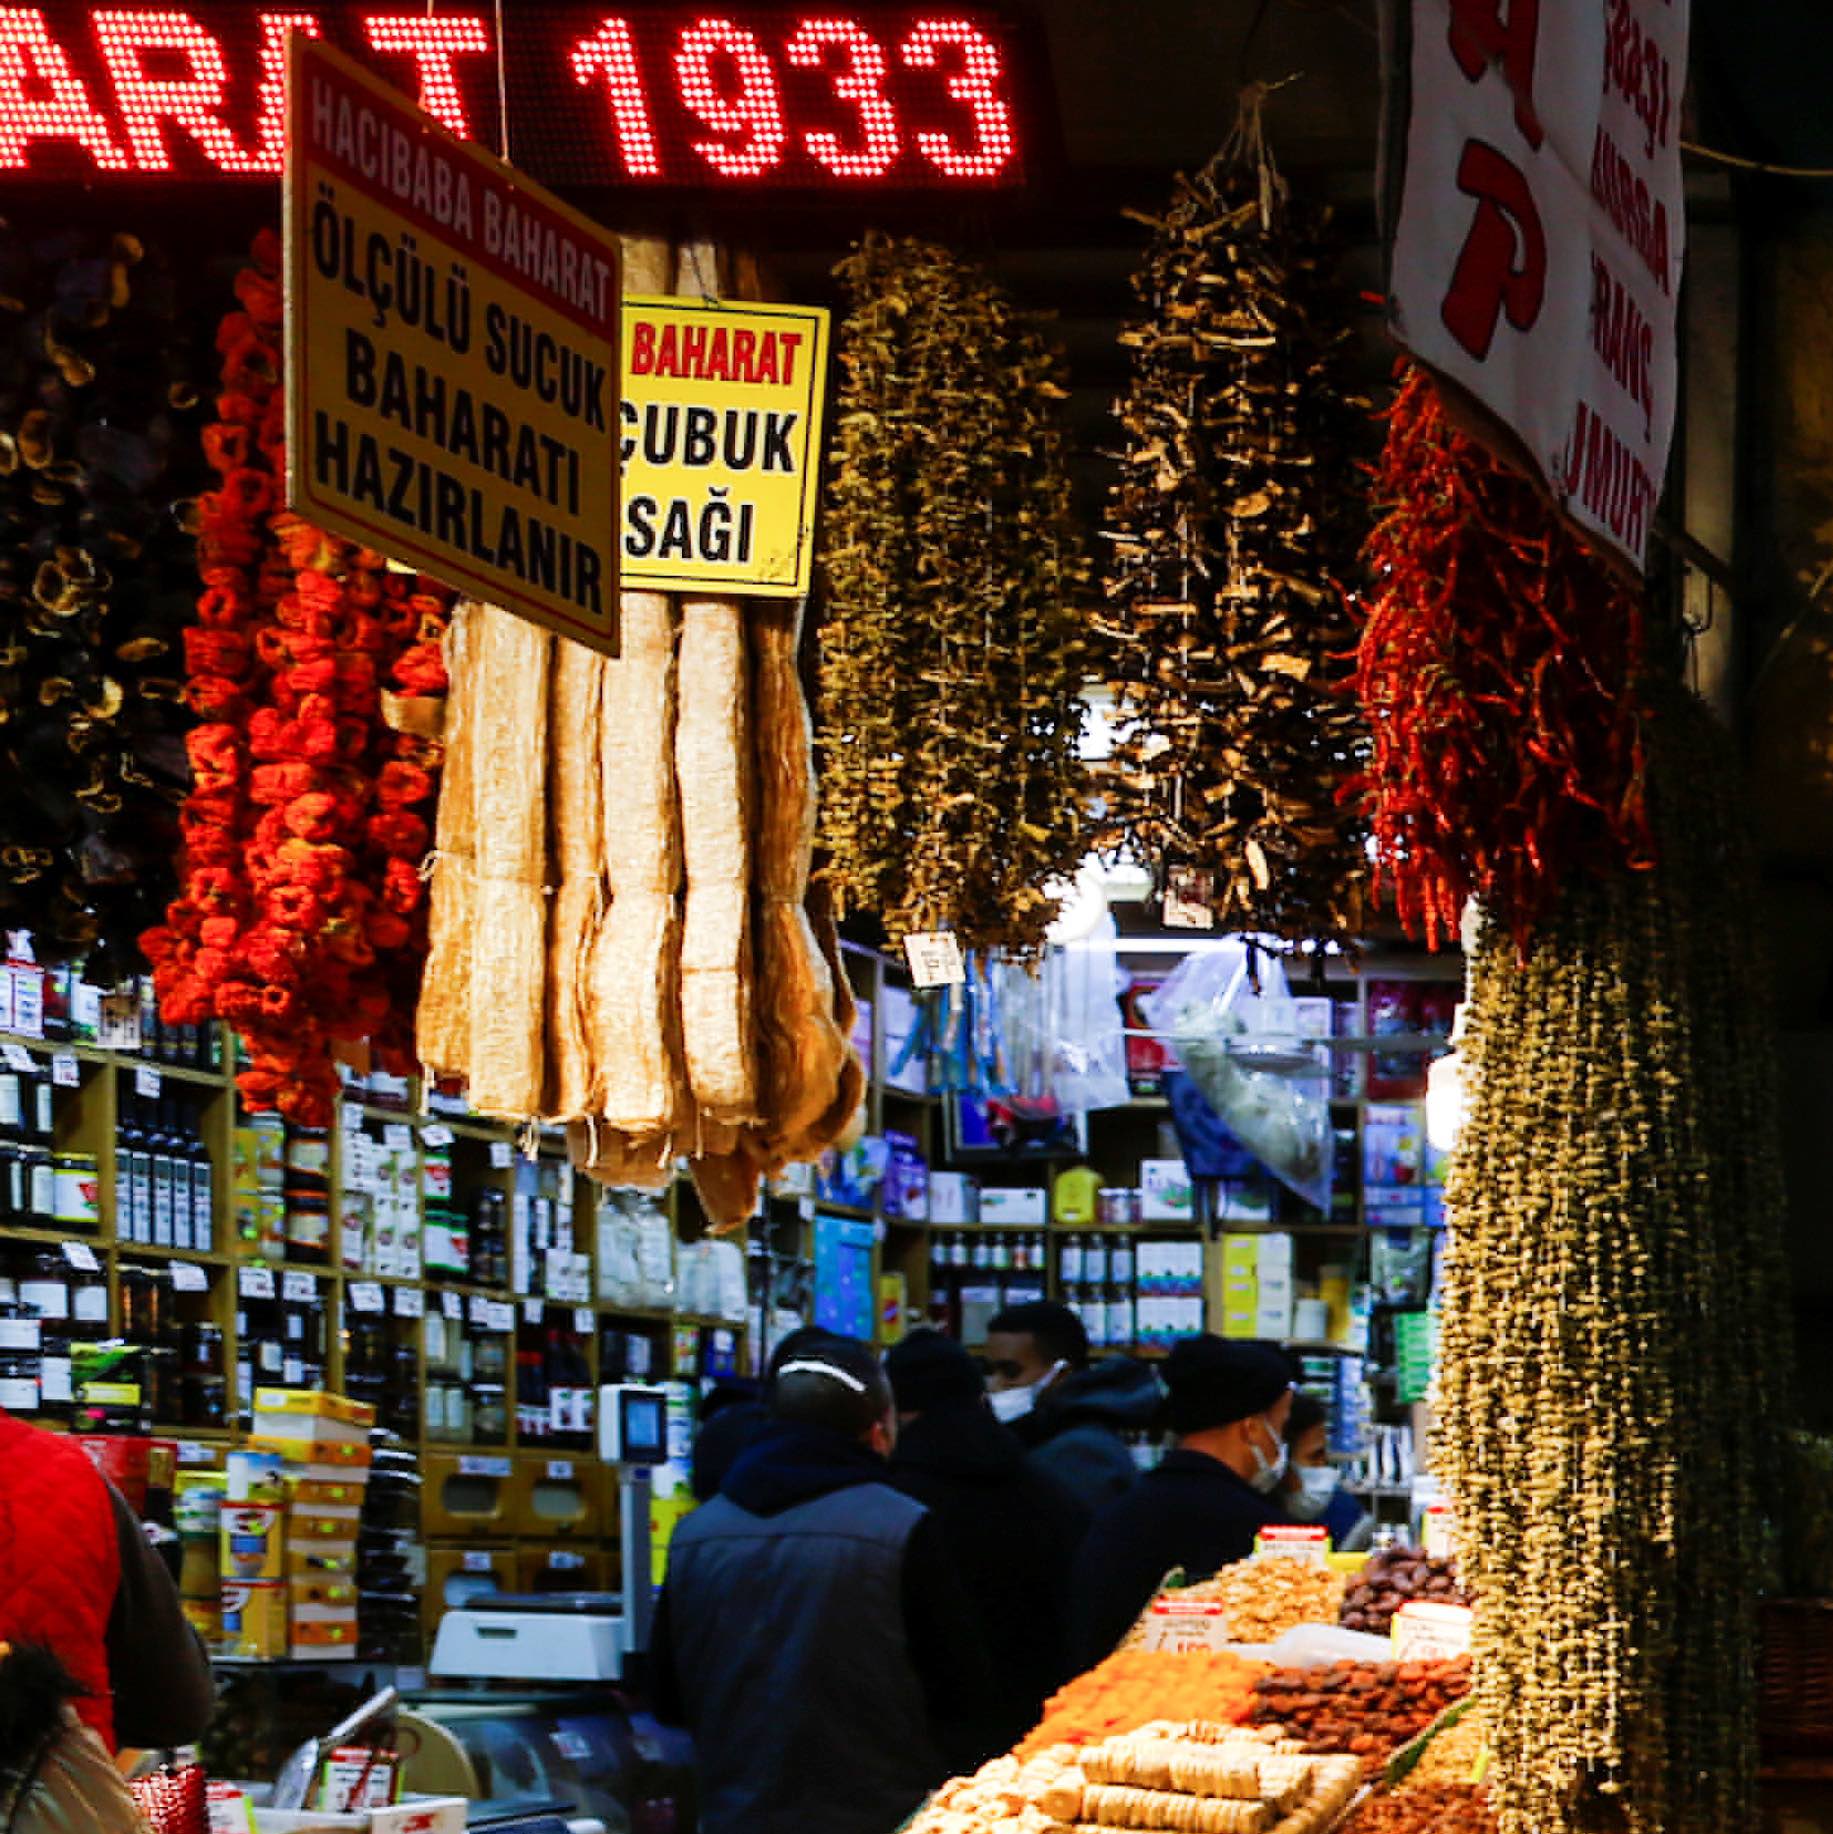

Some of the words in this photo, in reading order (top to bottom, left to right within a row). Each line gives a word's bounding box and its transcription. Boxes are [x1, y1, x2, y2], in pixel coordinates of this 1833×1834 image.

[570, 17, 1013, 178] 1933
[310, 73, 475, 243] HACIBABA
[482, 187, 612, 323] BAHARAT
[313, 181, 470, 356] ÖLÇÜLÜ
[486, 303, 605, 432] SUCUK
[631, 321, 803, 386] BAHARAT
[314, 409, 603, 616] HAZIRLANIR
[346, 327, 580, 516] BAHARATI
